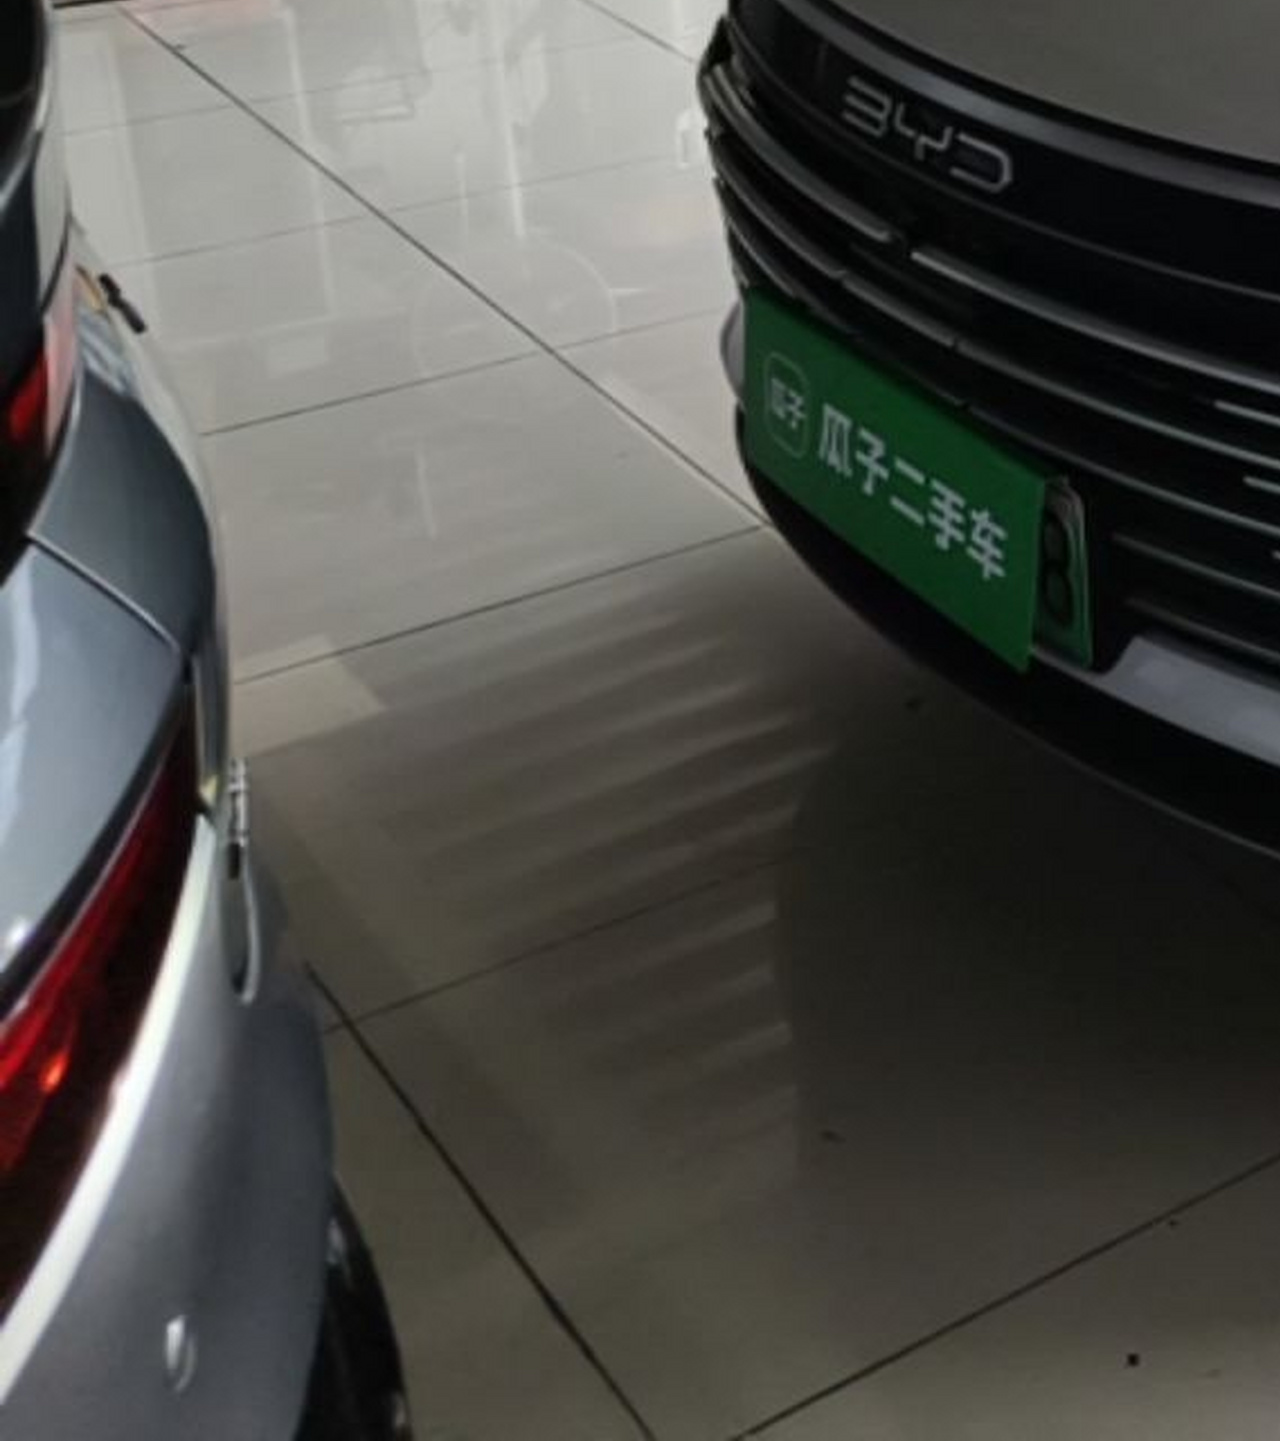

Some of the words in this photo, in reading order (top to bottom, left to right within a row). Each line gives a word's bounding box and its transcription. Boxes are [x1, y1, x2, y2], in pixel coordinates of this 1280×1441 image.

[843, 74, 1013, 192] BYD
[818, 401, 1008, 582] 瓜子二手车
